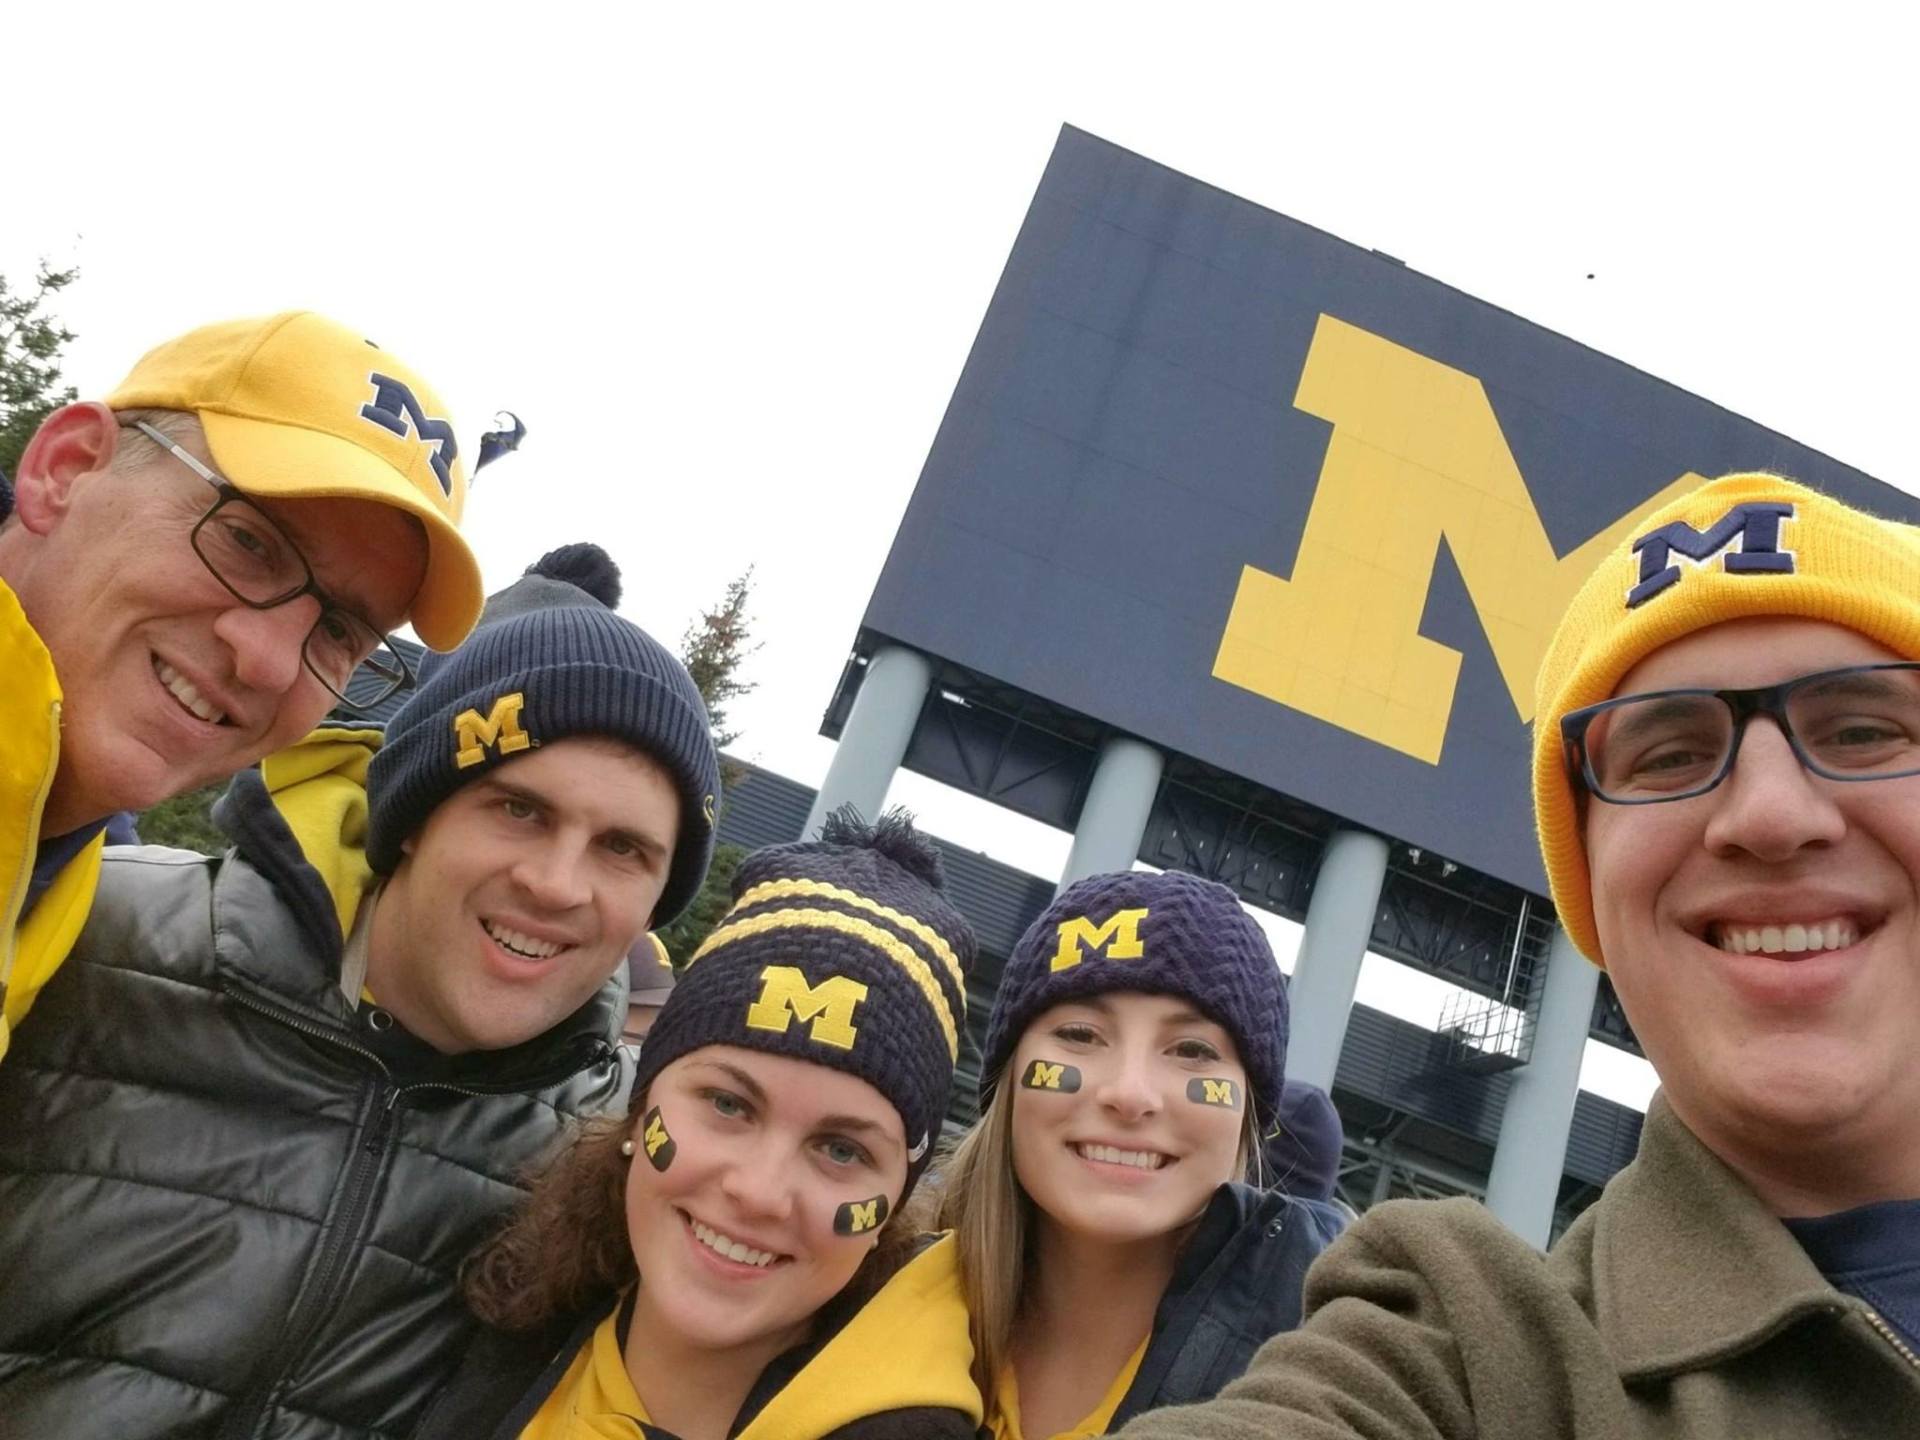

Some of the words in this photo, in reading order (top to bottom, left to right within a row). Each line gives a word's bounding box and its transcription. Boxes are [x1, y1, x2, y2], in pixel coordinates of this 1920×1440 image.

[361, 372, 459, 498] M
[1626, 502, 1798, 609] M
[454, 692, 530, 769] M
[1051, 908, 1149, 973] M
[746, 966, 868, 1050] M
[1031, 1062, 1063, 1089] M
[1204, 1079, 1233, 1106] M
[851, 1200, 878, 1231] M
